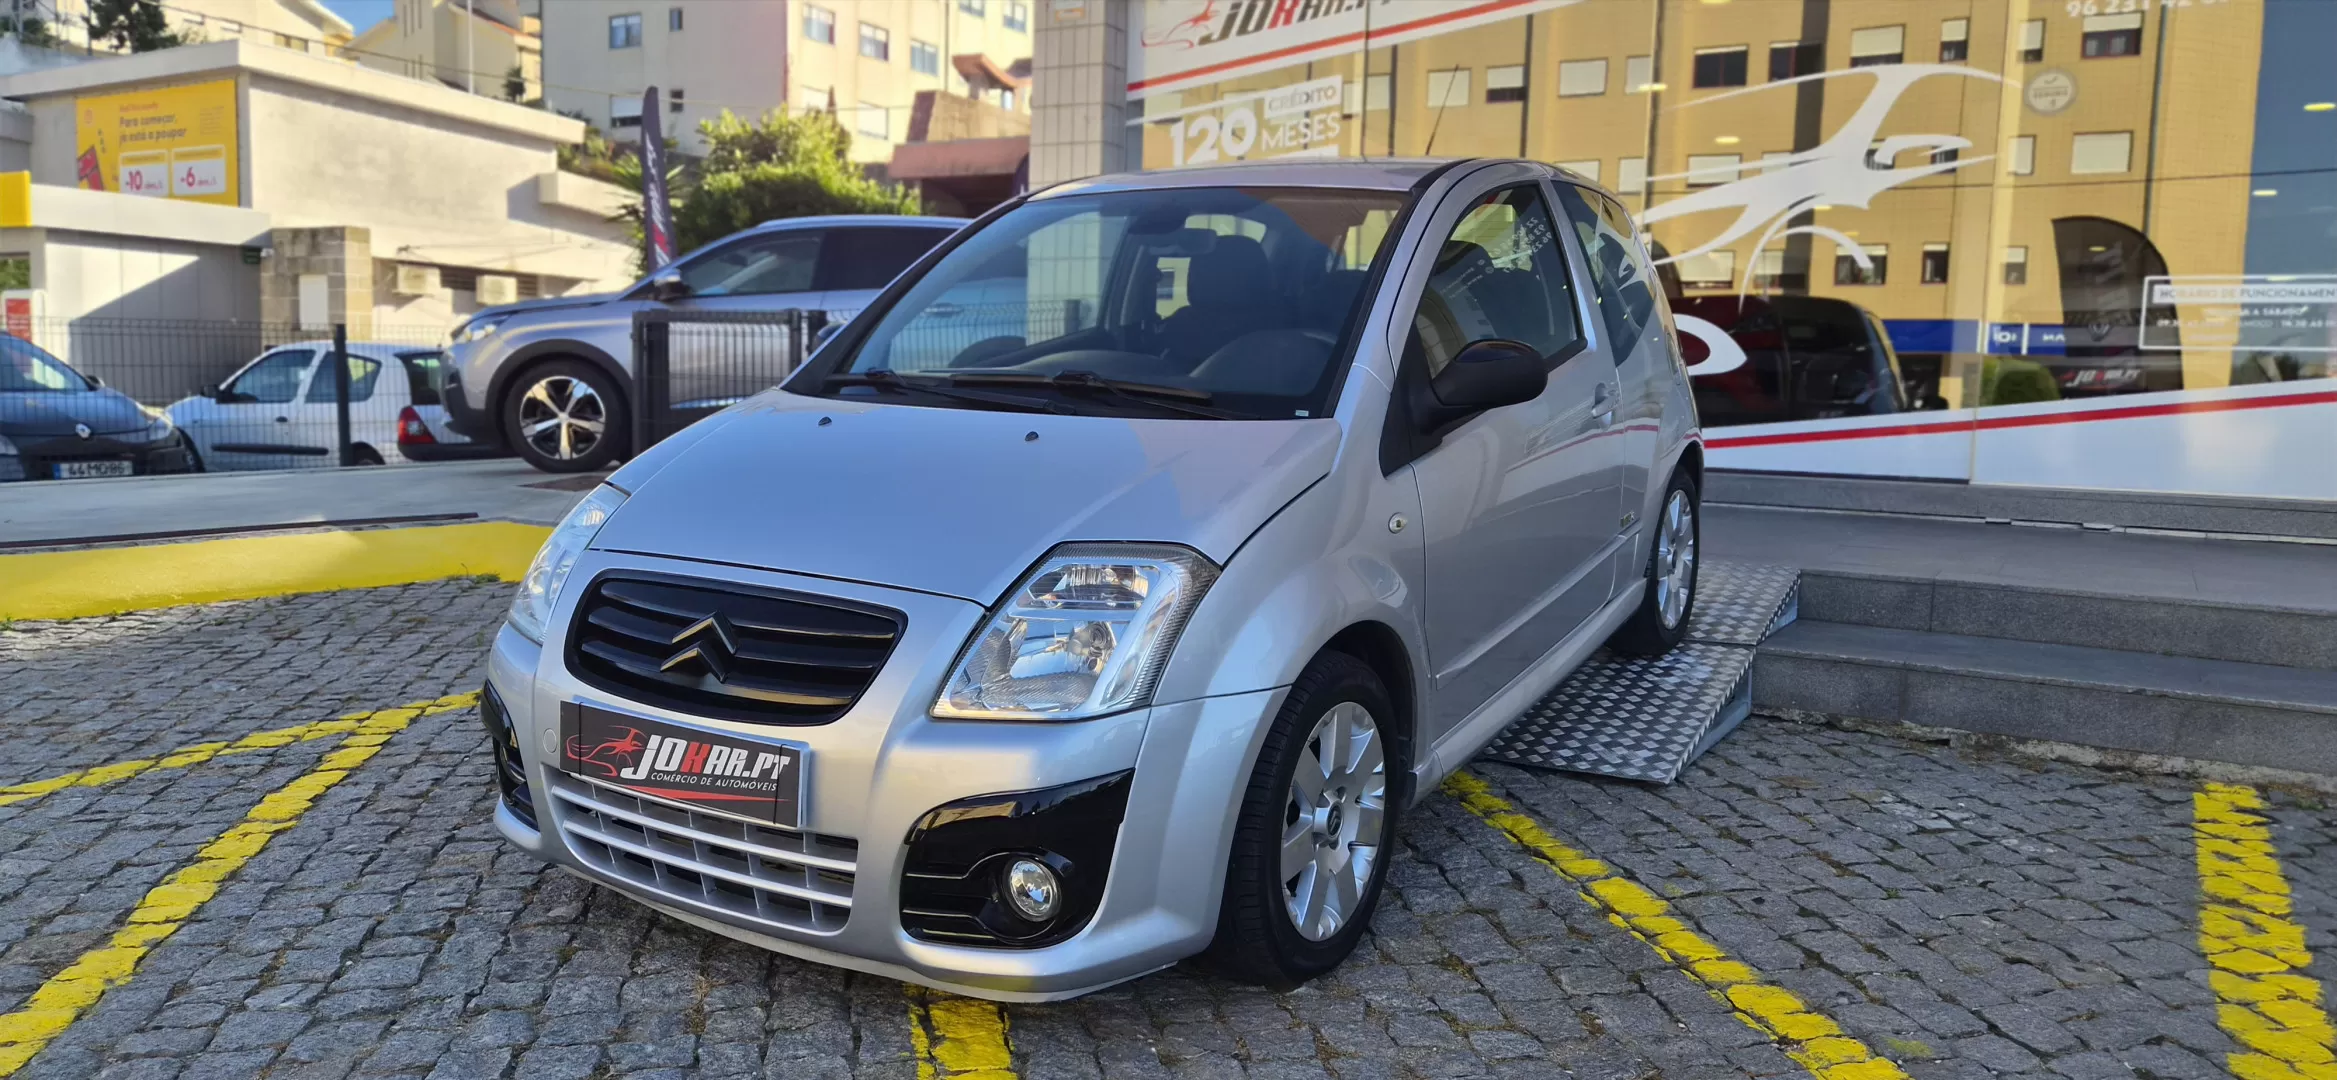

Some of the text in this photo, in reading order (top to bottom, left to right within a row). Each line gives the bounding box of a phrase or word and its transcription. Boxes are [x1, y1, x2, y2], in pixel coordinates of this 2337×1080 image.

[1268, 84, 1336, 112] CRÉDITO
[1170, 107, 1257, 168] 120
[1261, 111, 1341, 150] MESES
[2240, 287, 2337, 298] FUNCIONAMEN
[620, 734, 790, 780] JOKAR.PT
[651, 771, 778, 792] COMÉRCIO DE AUTOMÓVEIS
